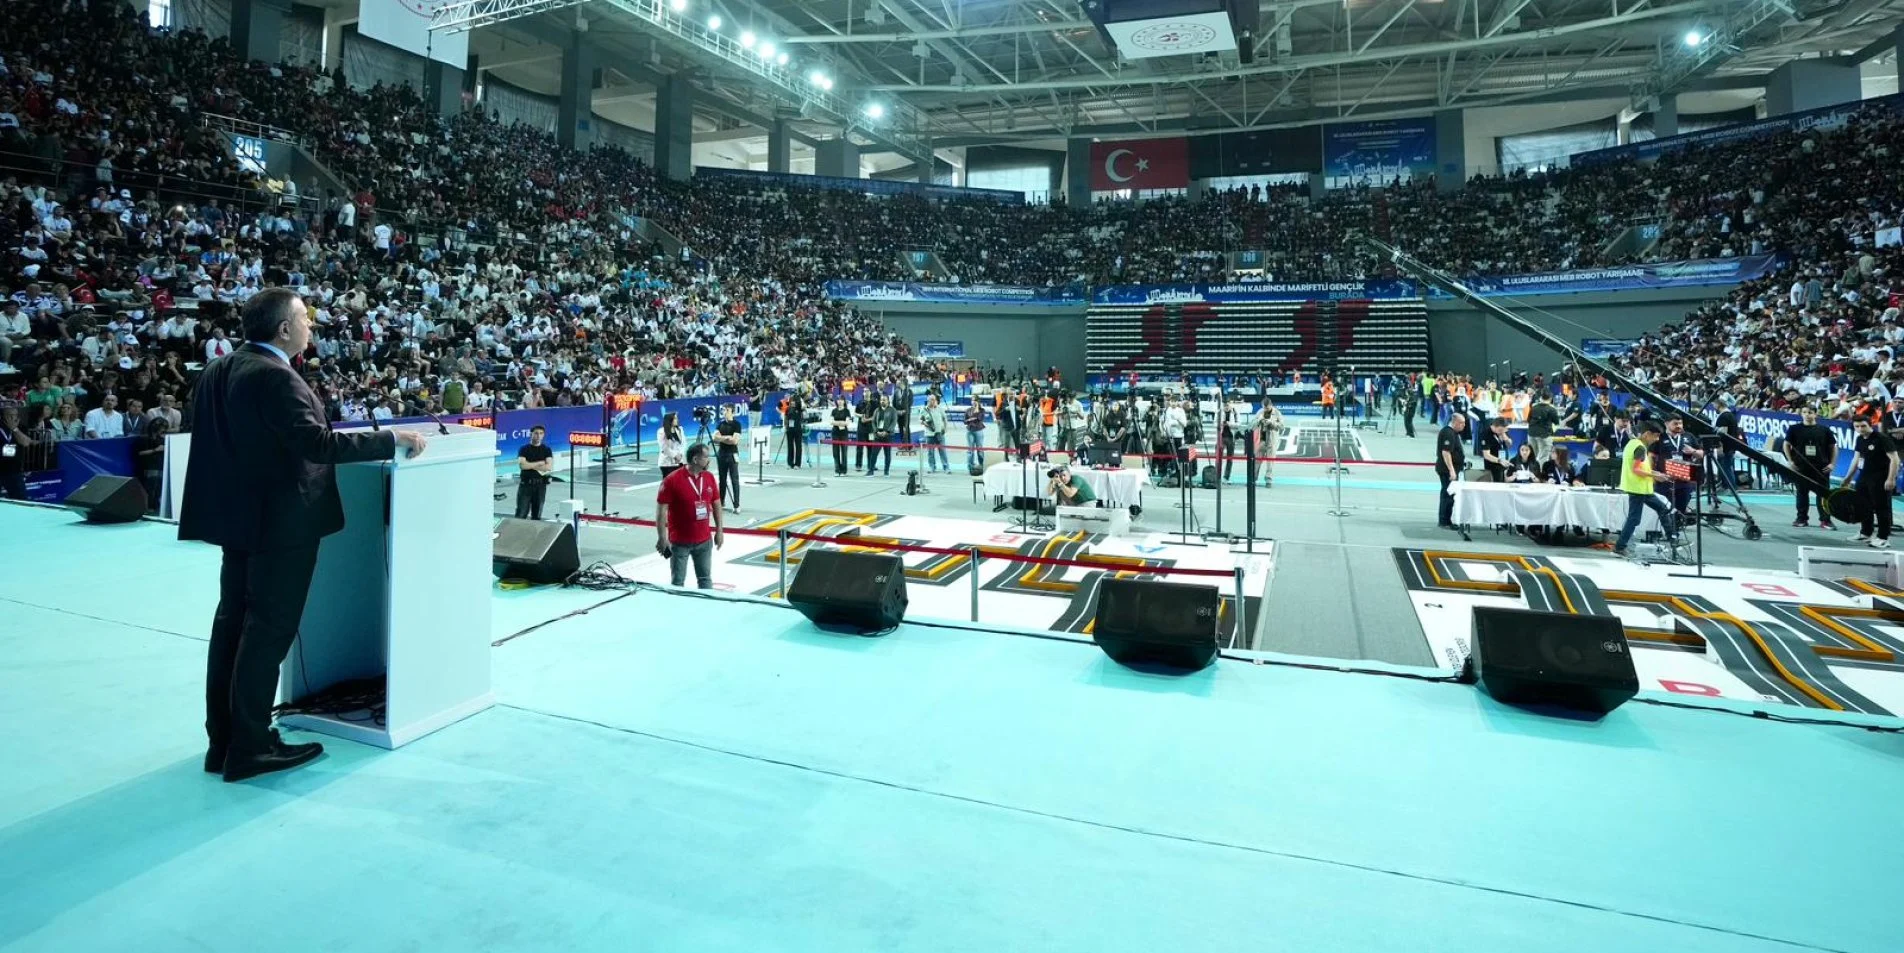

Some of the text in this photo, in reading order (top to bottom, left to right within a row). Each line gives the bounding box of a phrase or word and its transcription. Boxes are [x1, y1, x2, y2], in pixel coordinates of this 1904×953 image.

[235, 136, 263, 159] 205
[1576, 273, 1600, 281] ROBOT
[1208, 282, 1365, 293] MAARİFİN KALBİNDE MARİFETLİ GENÇLİK
[1329, 291, 1365, 299] BURADA
